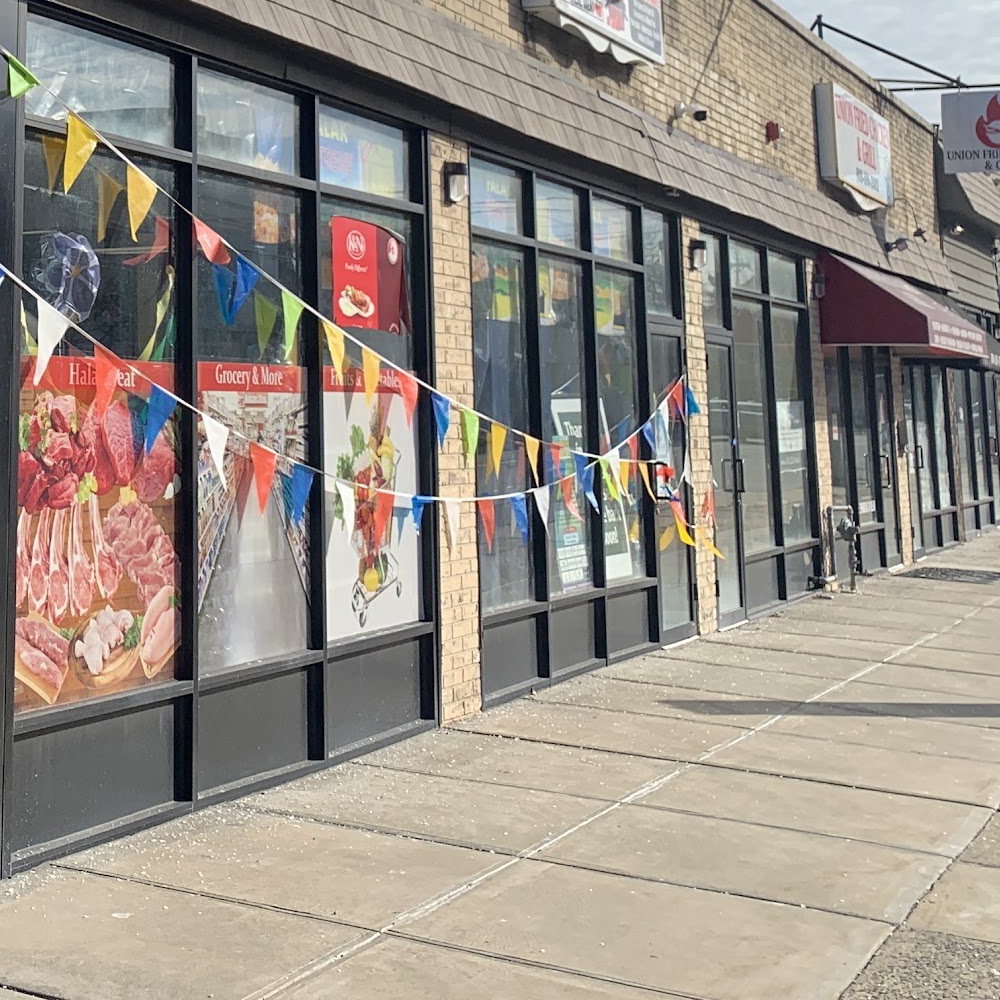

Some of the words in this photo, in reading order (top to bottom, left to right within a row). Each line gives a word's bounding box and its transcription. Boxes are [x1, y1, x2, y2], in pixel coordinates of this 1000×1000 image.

[947, 150, 980, 161] UNION
[983, 149, 1000, 160] FRI
[985, 160, 992, 170] &
[69, 362, 97, 386] Hala
[115, 368, 136, 388] eat
[215, 364, 251, 389] Grocery
[252, 368, 259, 384] &
[261, 367, 283, 386] More
[330, 368, 354, 387] Frits
[355, 369, 362, 387] &
